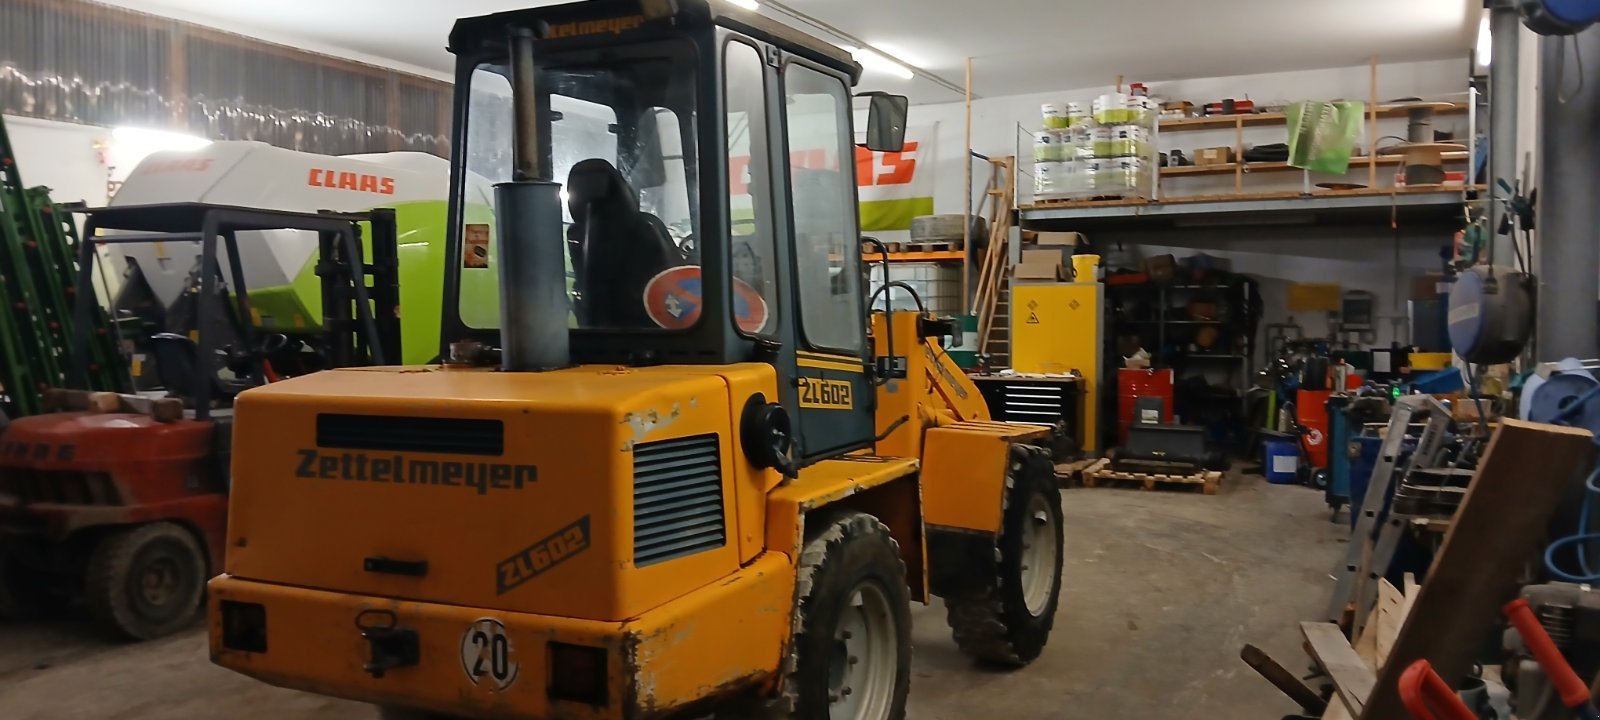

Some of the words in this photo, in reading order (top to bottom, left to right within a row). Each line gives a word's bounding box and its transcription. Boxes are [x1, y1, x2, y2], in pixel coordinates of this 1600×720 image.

[308, 168, 395, 195] CLAAS
[799, 382, 850, 405] ZL602
[295, 448, 539, 495] Zettelmeyer
[501, 525, 587, 587] ZL602
[472, 630, 508, 680] 20
